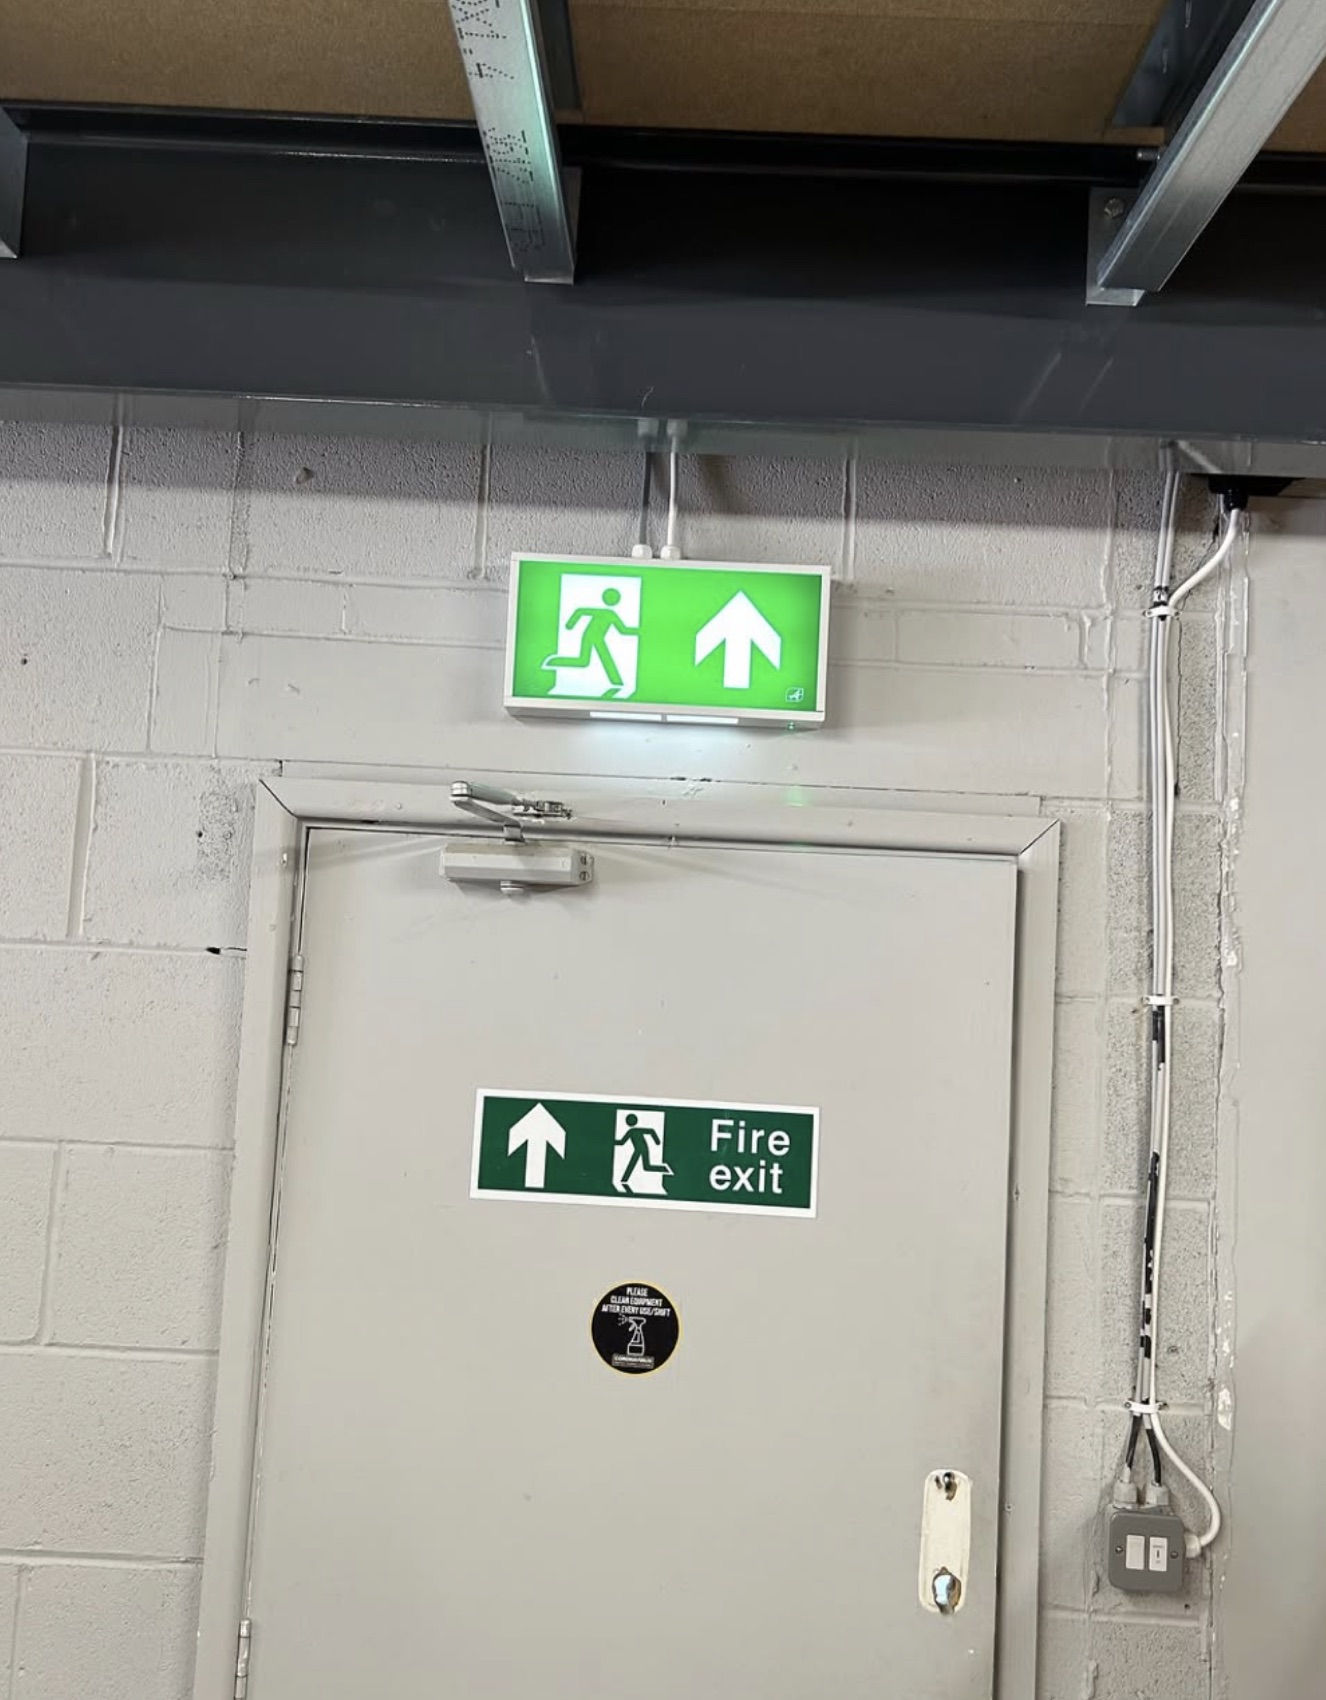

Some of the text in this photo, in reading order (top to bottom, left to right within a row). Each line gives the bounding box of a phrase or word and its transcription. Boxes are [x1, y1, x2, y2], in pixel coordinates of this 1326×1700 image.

[710, 1119, 790, 1157] Fire
[709, 1160, 783, 1194] exit
[627, 1287, 648, 1296] PLEASE
[610, 1295, 663, 1307] CLEAN EQUIPMENT
[602, 1304, 620, 1312] AFTER
[621, 1305, 639, 1314] EVERY
